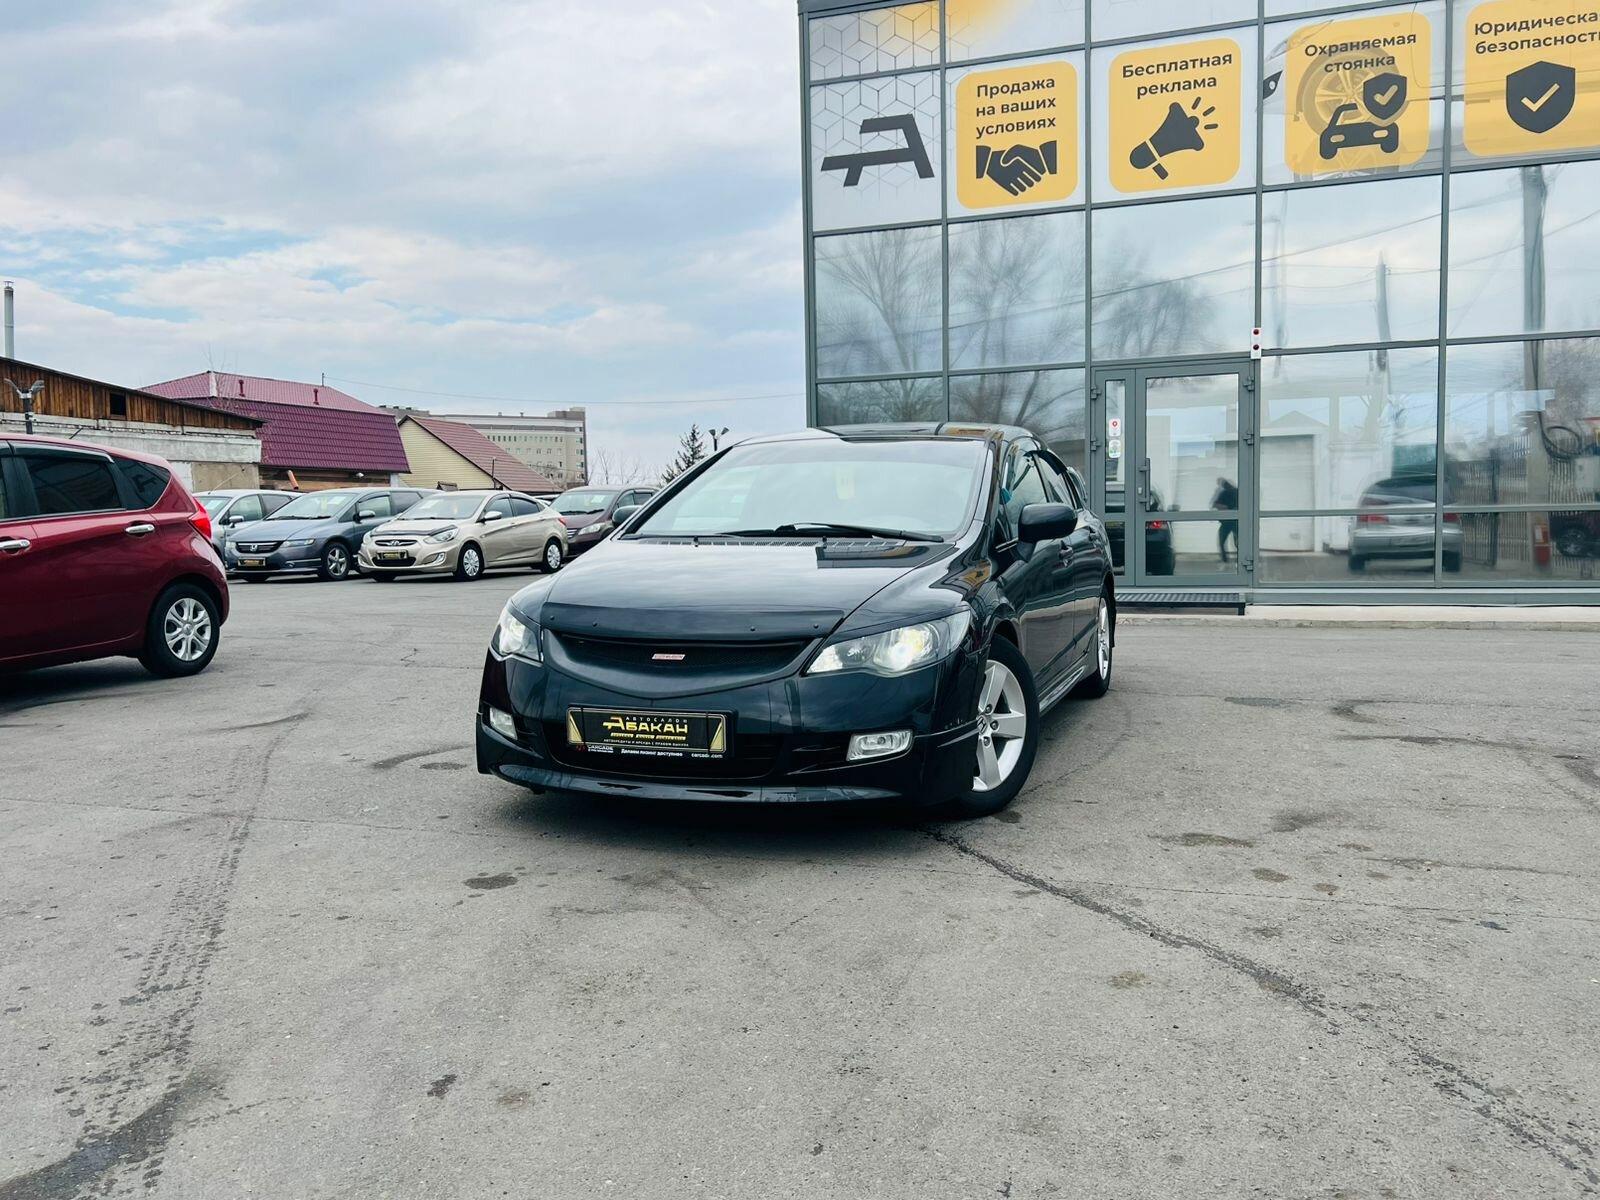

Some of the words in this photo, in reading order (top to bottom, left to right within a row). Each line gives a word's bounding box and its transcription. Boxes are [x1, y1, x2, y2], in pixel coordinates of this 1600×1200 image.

[1474, 12, 1600, 36] Юридическа
[1304, 34, 1417, 57] Охраняемая
[1122, 54, 1232, 78] Бесплатная
[1324, 56, 1396, 73] стоянка
[977, 78, 1055, 99] Продажа
[1137, 76, 1217, 100] реклама
[976, 105, 996, 117] на
[1001, 97, 1056, 114] ваших
[976, 117, 1056, 139] условиях
